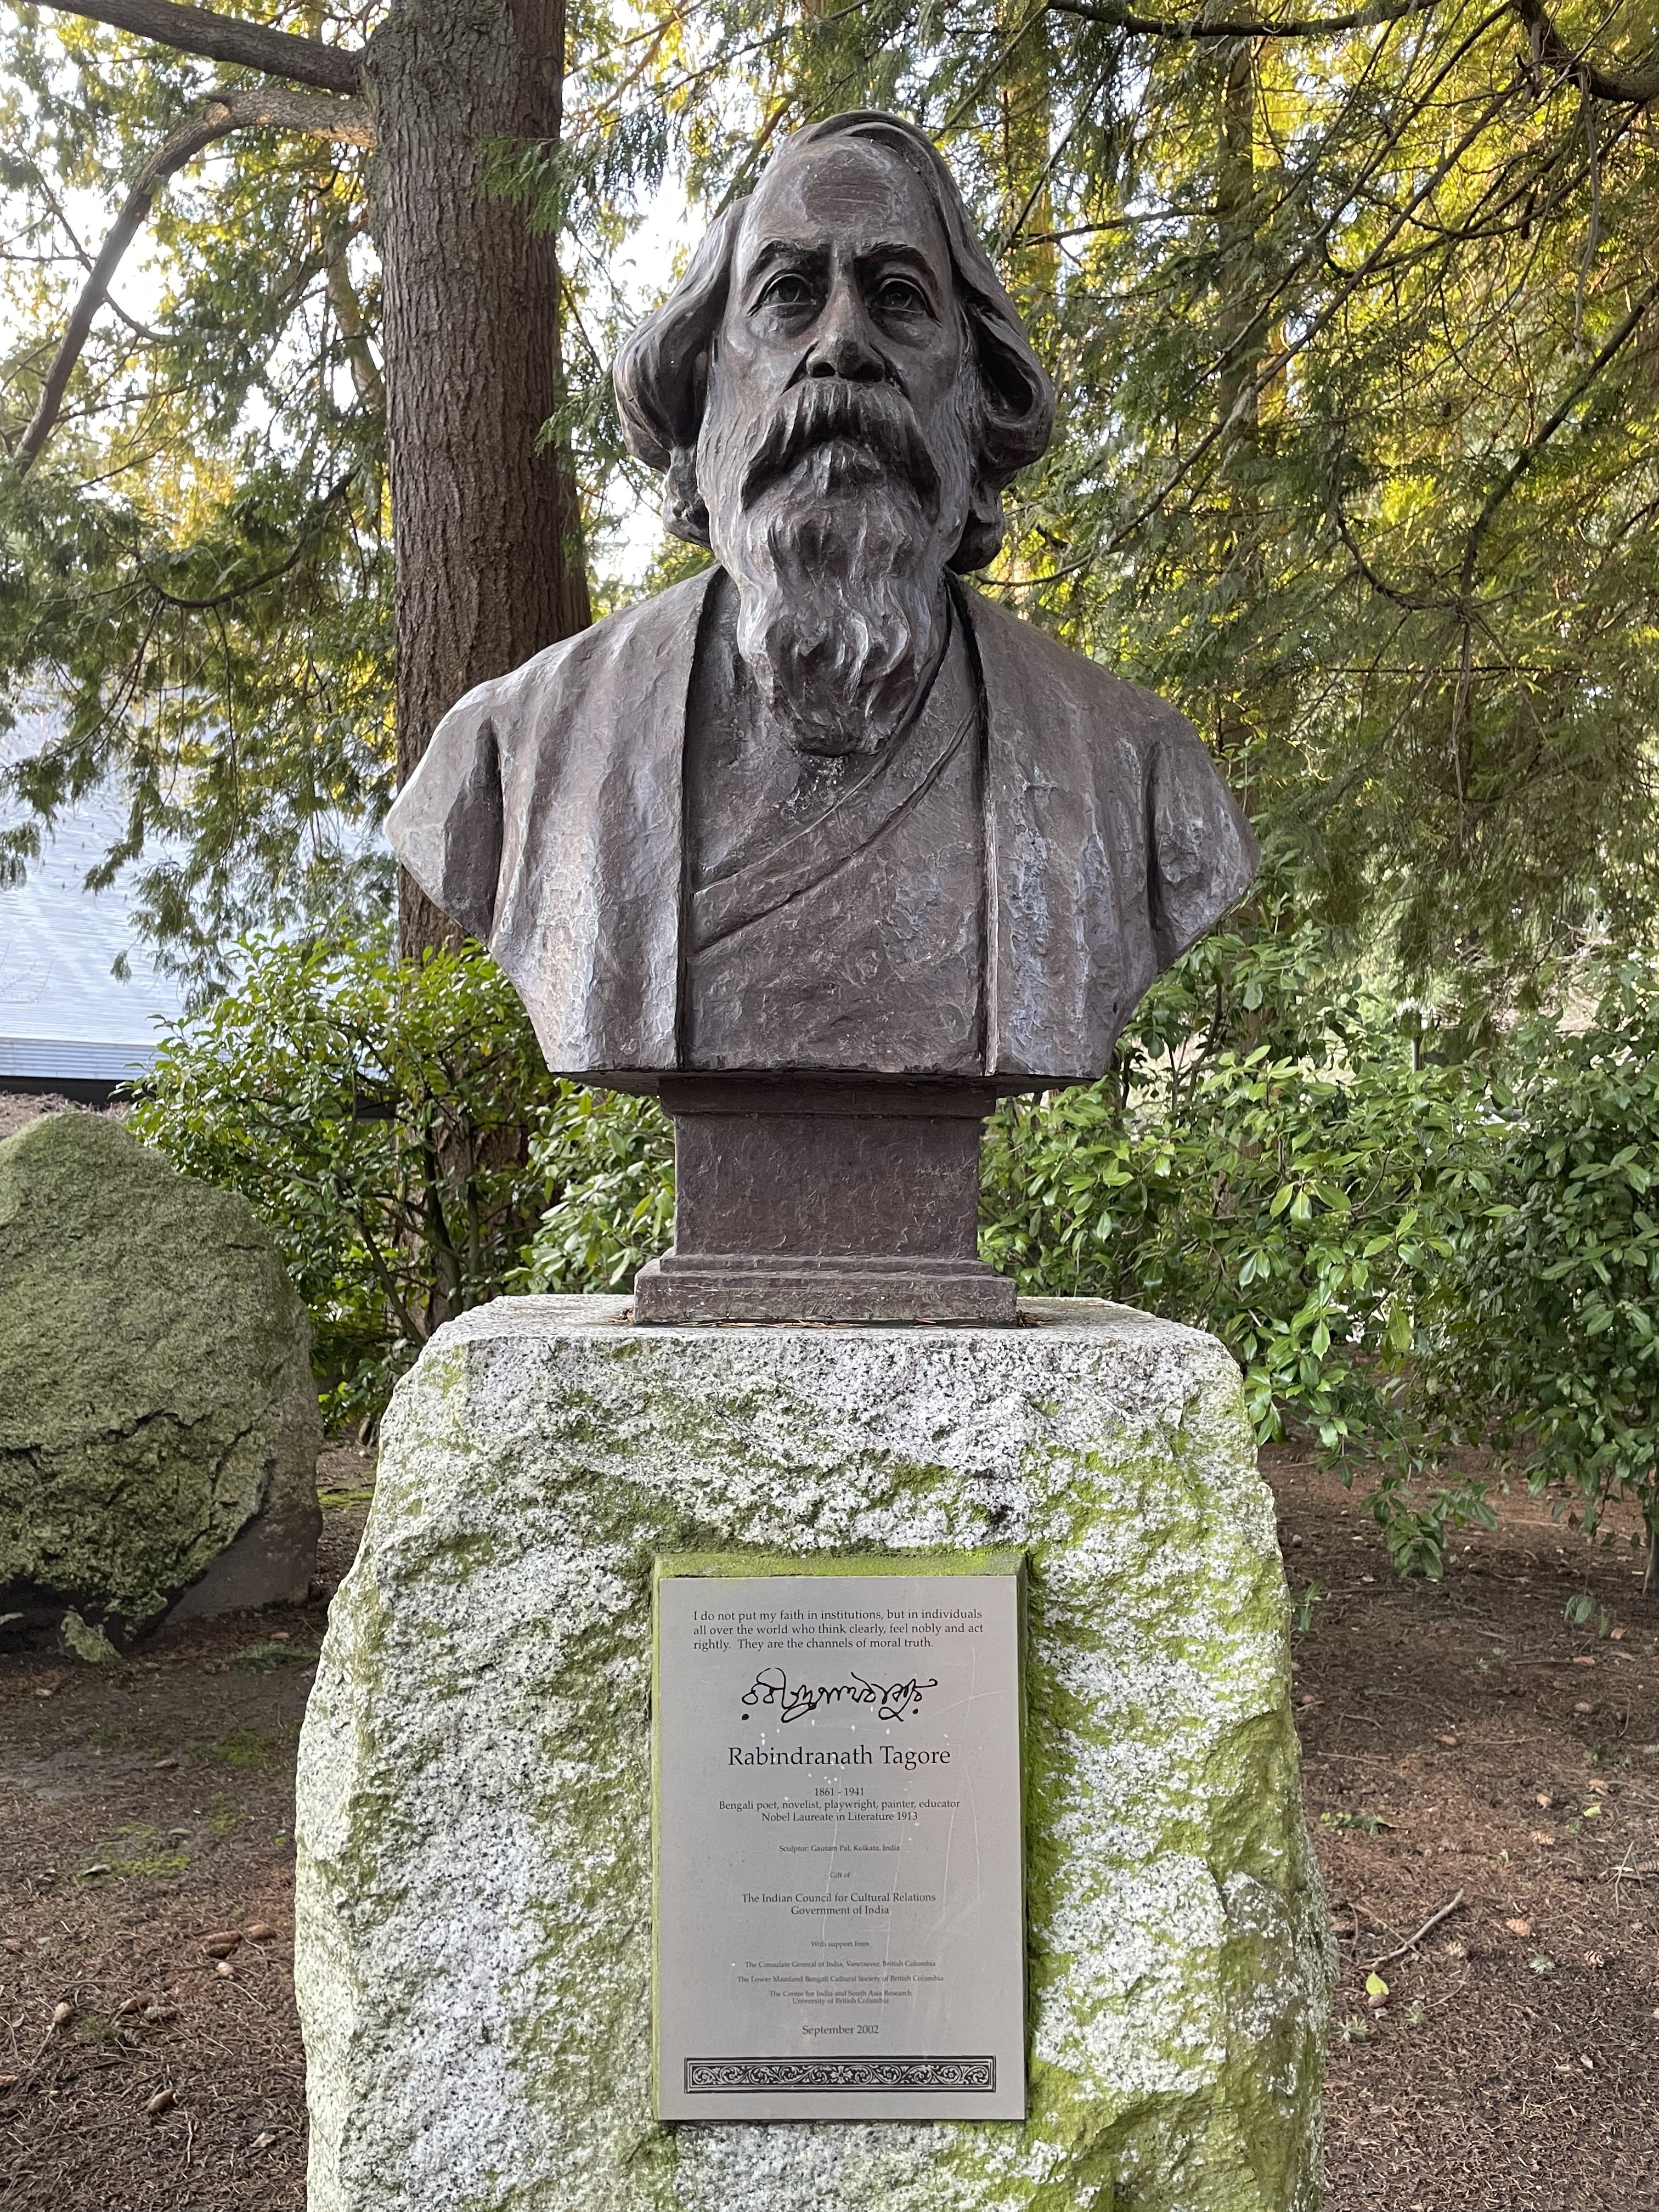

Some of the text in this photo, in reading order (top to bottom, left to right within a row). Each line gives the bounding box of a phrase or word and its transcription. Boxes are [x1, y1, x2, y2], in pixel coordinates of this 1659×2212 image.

[693, 1609, 983, 1623] I do not put my faith in institutions, but in individuals
[693, 1625, 706, 1635] all
[737, 1624, 753, 1635] the
[756, 1624, 788, 1634] world
[791, 1623, 815, 1634] who
[818, 1623, 847, 1634] think
[849, 1623, 886, 1637] clearly,
[890, 1623, 908, 1633] feel
[911, 1623, 941, 1636] nobly
[945, 1623, 965, 1633] and
[968, 1624, 984, 1633] act
[693, 1638, 731, 1652] rightly.
[737, 1638, 764, 1652] They
[787, 1638, 804, 1648] the
[806, 1637, 853, 1648] channels
[856, 1637, 867, 1648] of
[870, 1637, 901, 1647] moral
[905, 1637, 934, 1647] truth.
[728, 1745, 950, 1771] Rabindranath Tagore
[815, 1787, 834, 1796] 1861
[844, 1787, 864, 1796] 1941
[719, 1799, 961, 1813] Bengali poet, novelist, playwright, painter, educator
[761, 1812, 918, 1821] Nobel Laureate in Literature 1913
[779, 1845, 810, 1854] Sculptor:
[741, 1892, 936, 1903] The Indian Council for Cultural Relations
[791, 1905, 889, 1915] Government of India
[827, 1941, 854, 1949] support
[758, 1960, 791, 1968] Consulate
[826, 1960, 845, 1968] India,
[805, 1975, 829, 1984] Bengali
[857, 1975, 881, 1983] Society
[792, 1997, 826, 2006] University
[802, 2024, 879, 2037] September 2002
